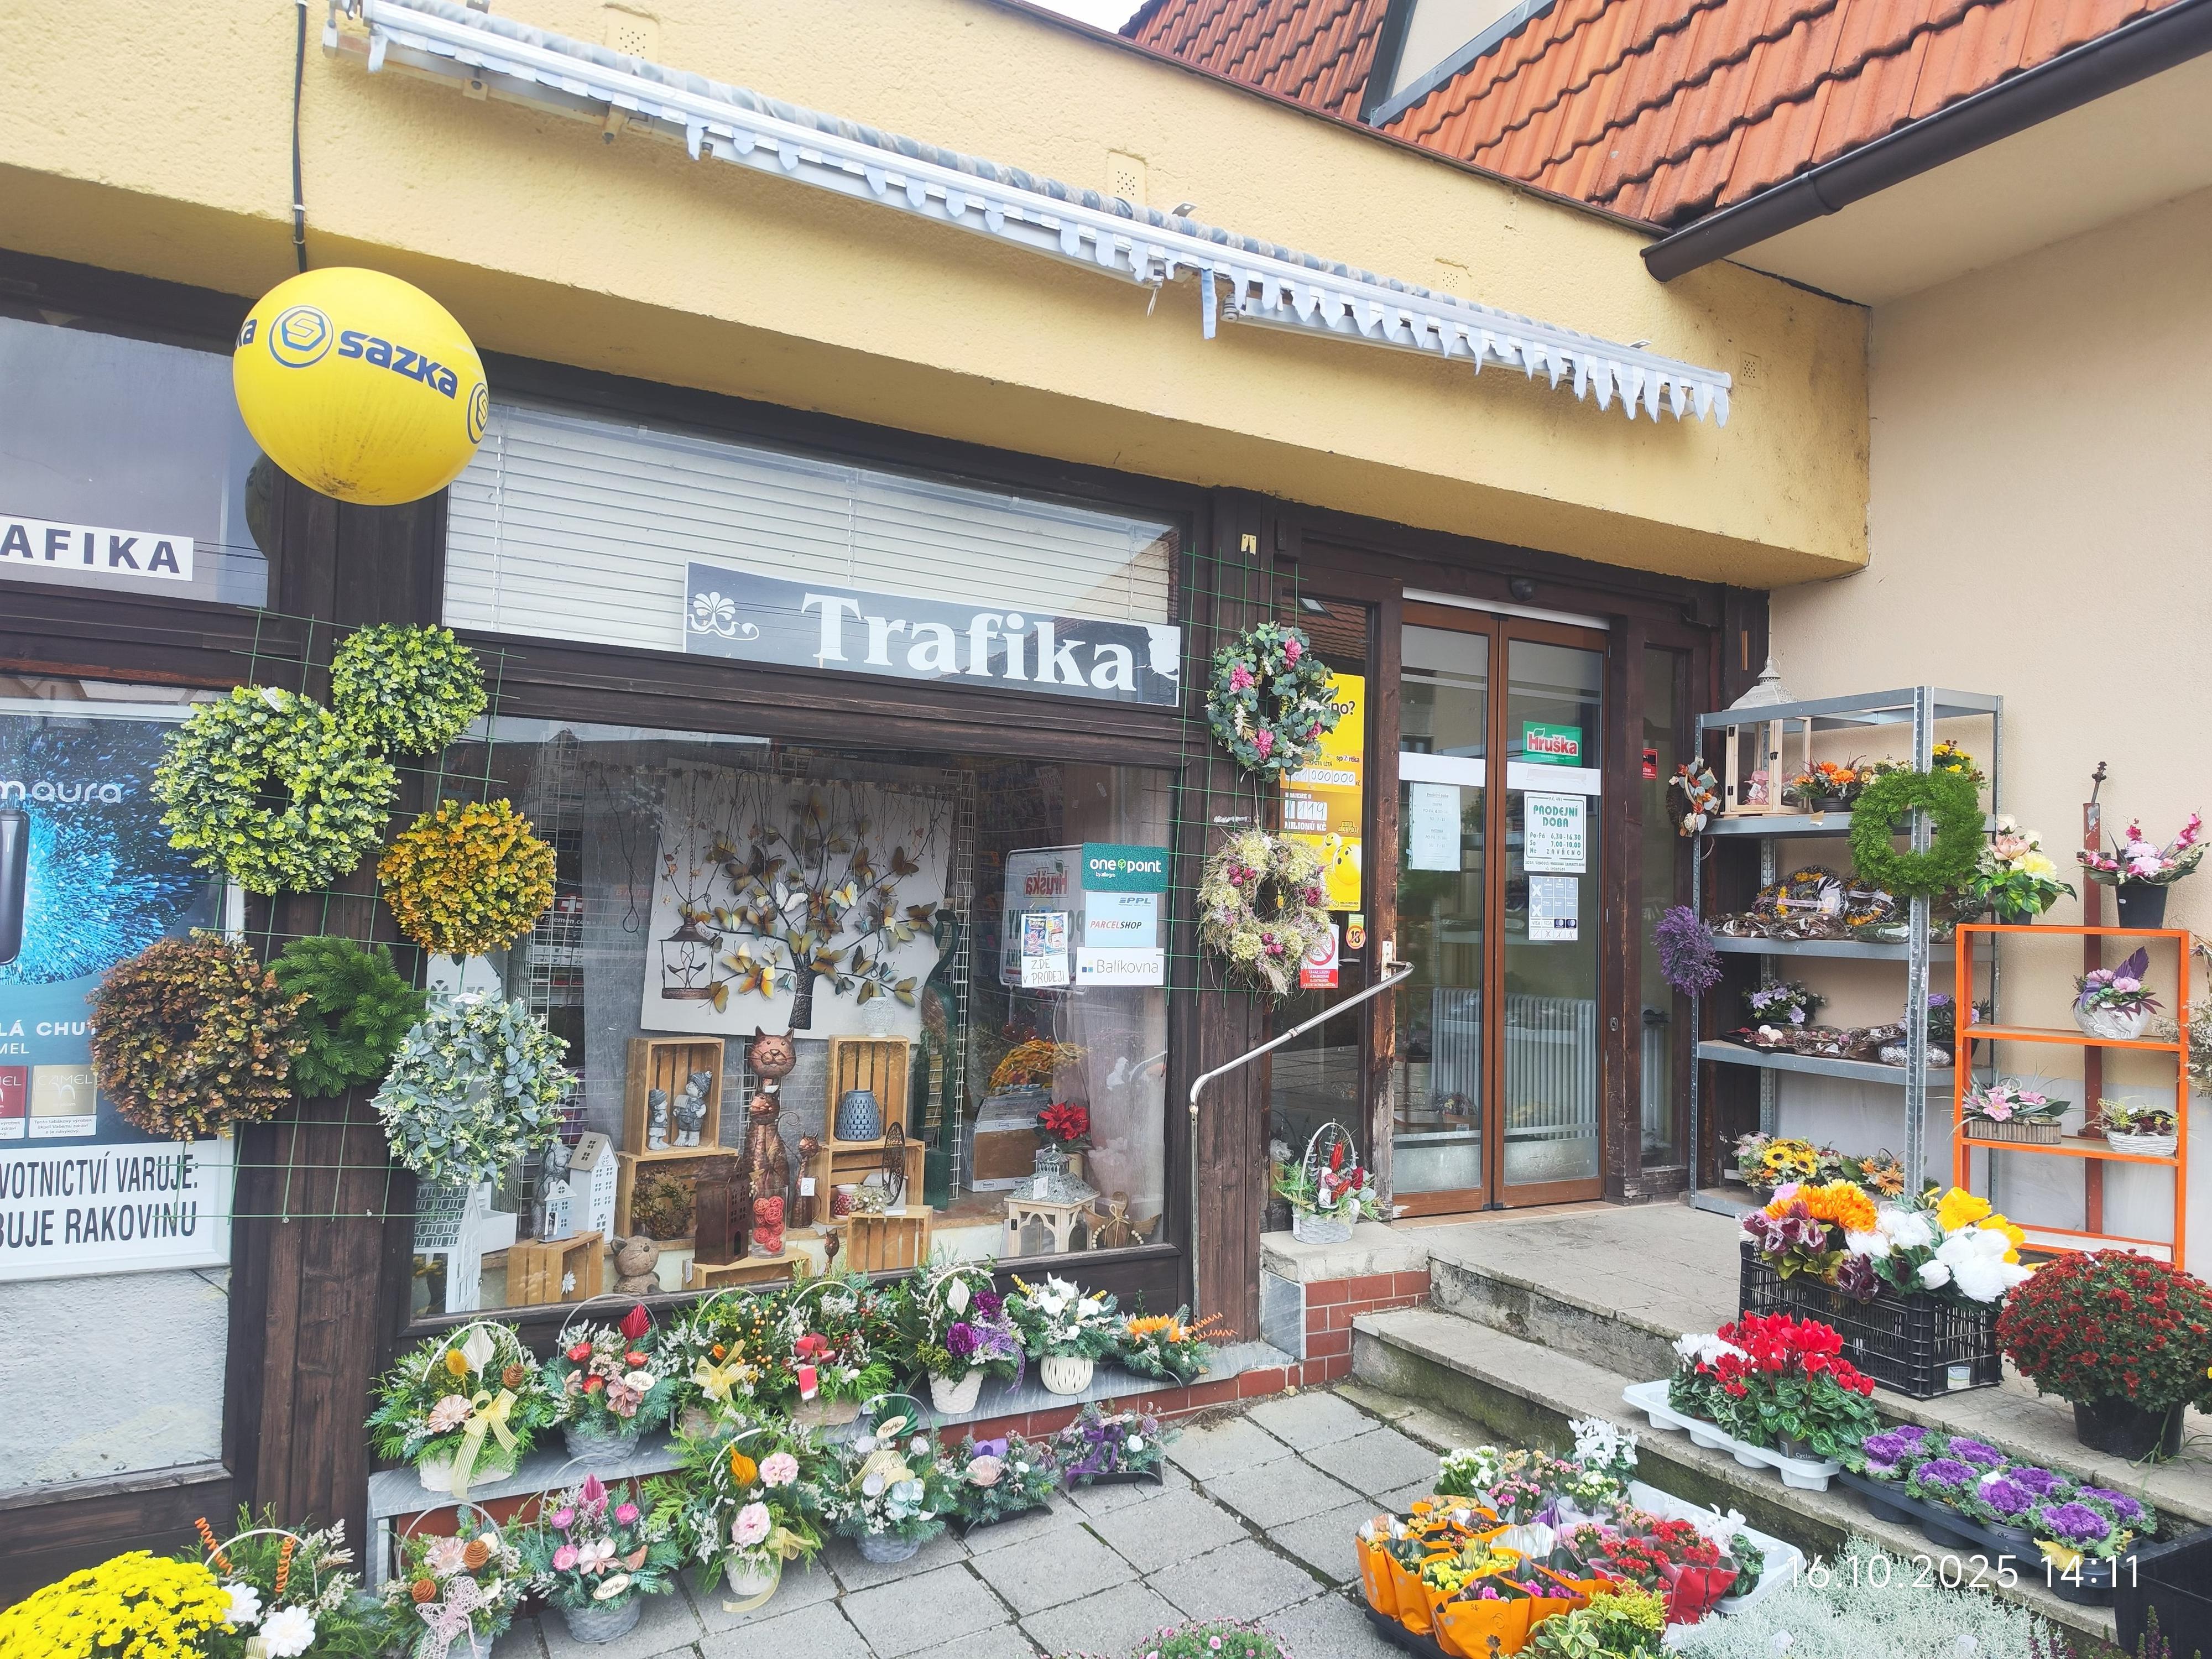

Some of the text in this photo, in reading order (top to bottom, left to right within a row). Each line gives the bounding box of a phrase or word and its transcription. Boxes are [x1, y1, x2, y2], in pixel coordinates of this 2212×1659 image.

[338, 329, 458, 399] sazka
[0, 524, 181, 574] AFIKA
[801, 592, 1138, 692] Trafika
[1528, 733, 1577, 754] Hruška
[1533, 805, 1578, 817] PRODEJNÍ
[1542, 817, 1569, 827] DOBA
[1090, 920, 1142, 929] PARCELSHOP
[1351, 931, 1360, 943] 18
[1031, 958, 1050, 970] ZDE
[1096, 959, 1159, 974] Balíkovna
[1032, 971, 1065, 984] PRODEJI
[116, 1154, 198, 1193] VARUJE:
[64, 1201, 197, 1244] RAKOVINU
